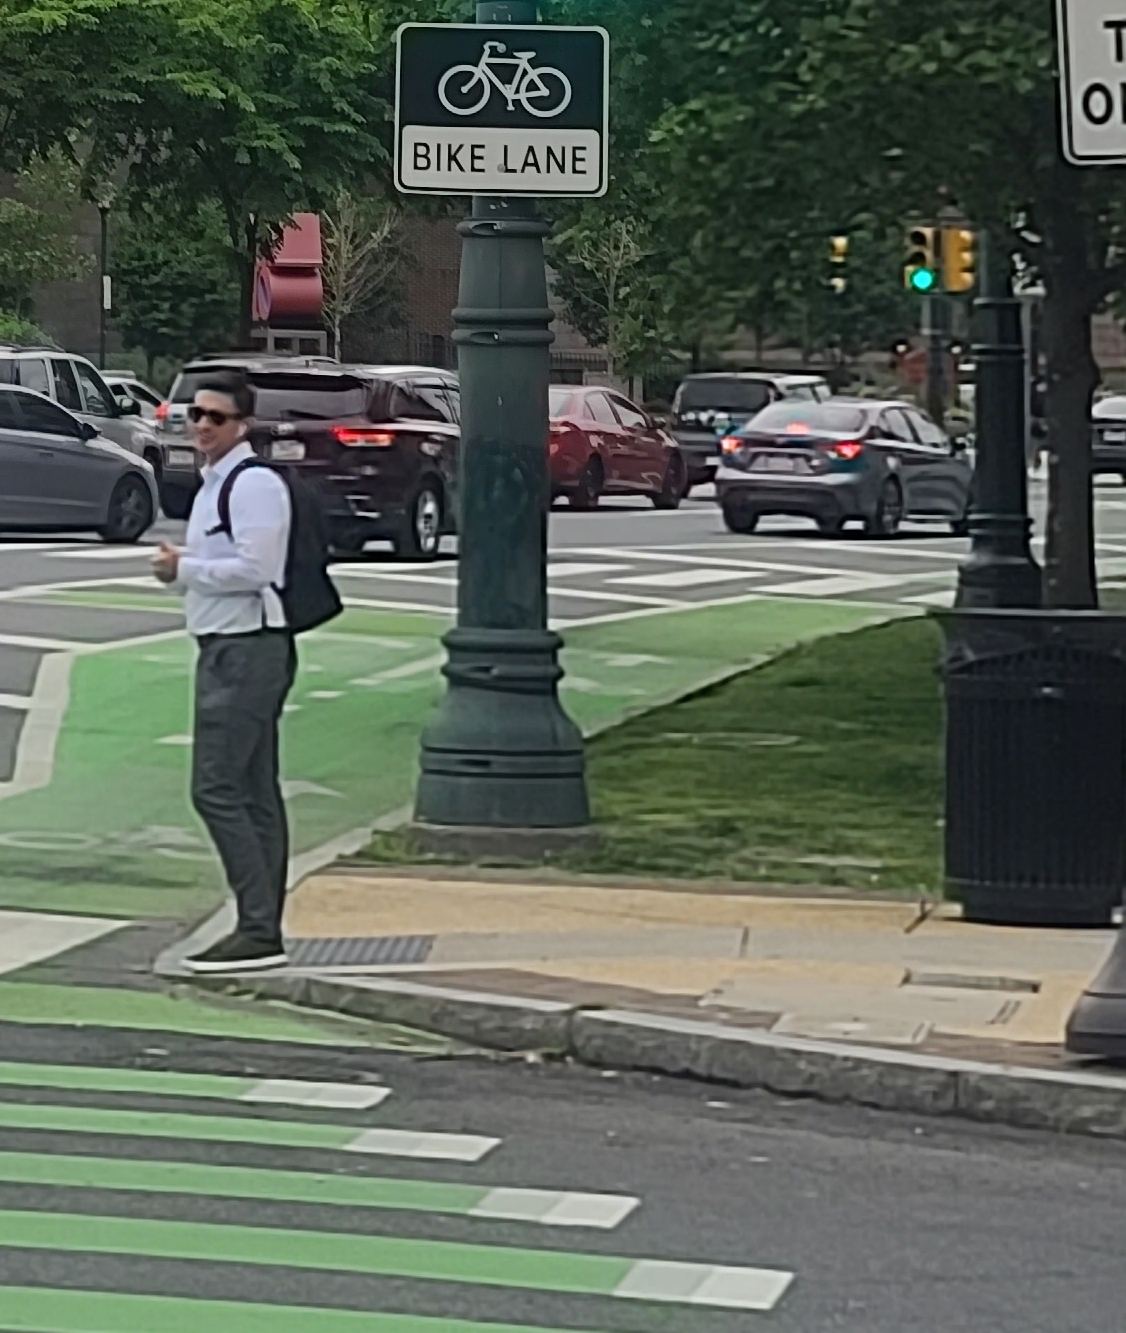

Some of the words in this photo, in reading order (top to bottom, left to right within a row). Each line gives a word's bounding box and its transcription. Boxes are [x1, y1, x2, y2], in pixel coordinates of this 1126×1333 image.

[1082, 81, 1126, 125] O
[412, 141, 486, 174] BIKE
[502, 144, 588, 175] LANE
